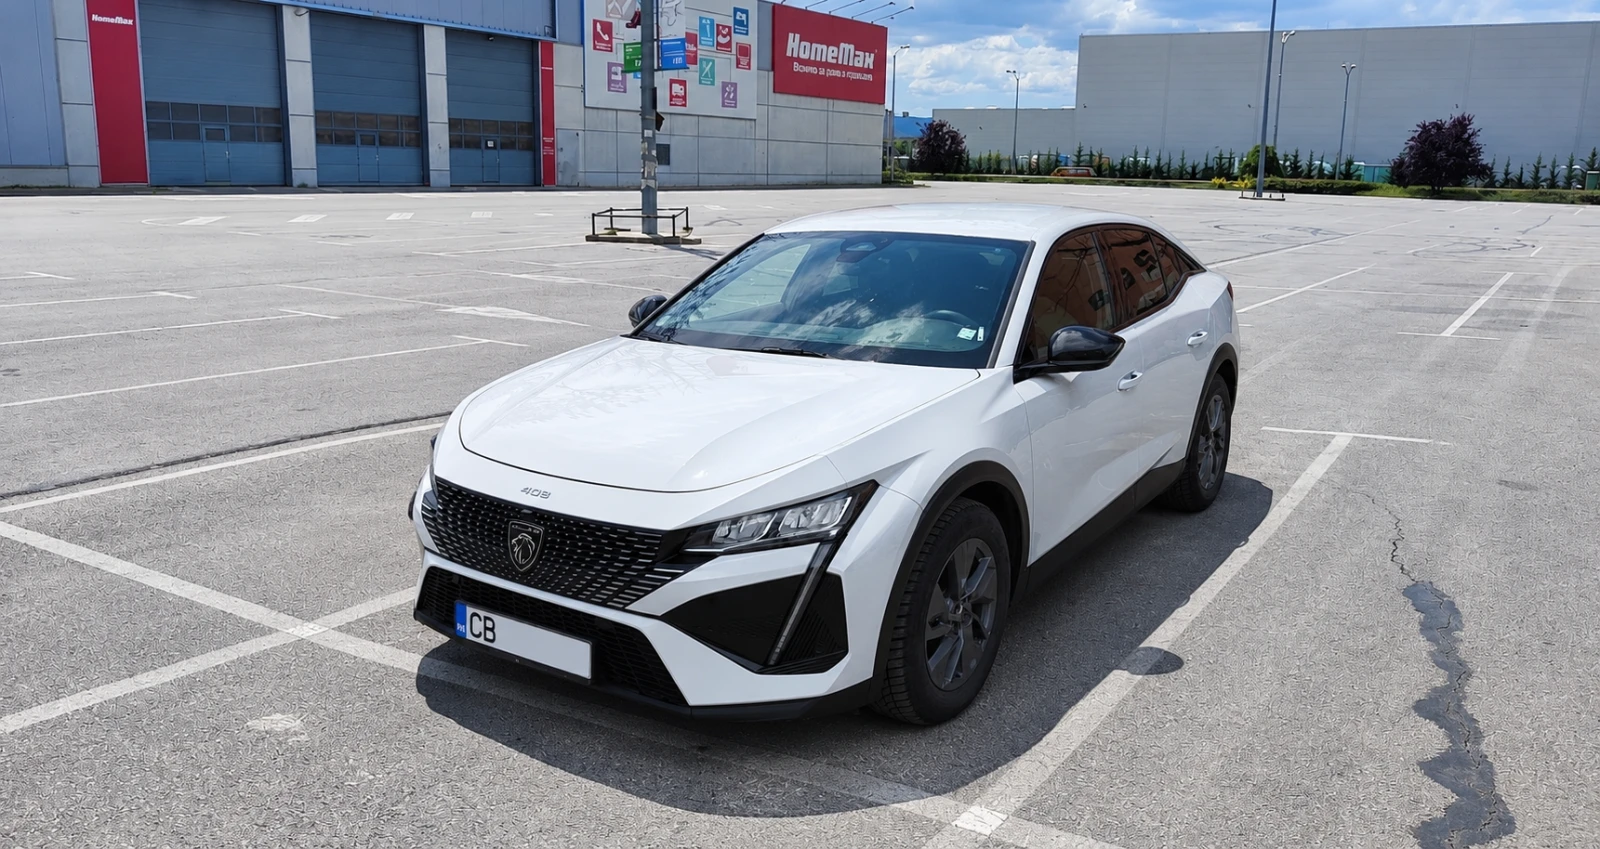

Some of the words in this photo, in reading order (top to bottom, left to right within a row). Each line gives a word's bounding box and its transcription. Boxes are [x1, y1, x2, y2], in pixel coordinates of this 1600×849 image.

[91, 14, 133, 25] HomeMax
[786, 32, 875, 69] HomeMax
[470, 611, 496, 643] CB
